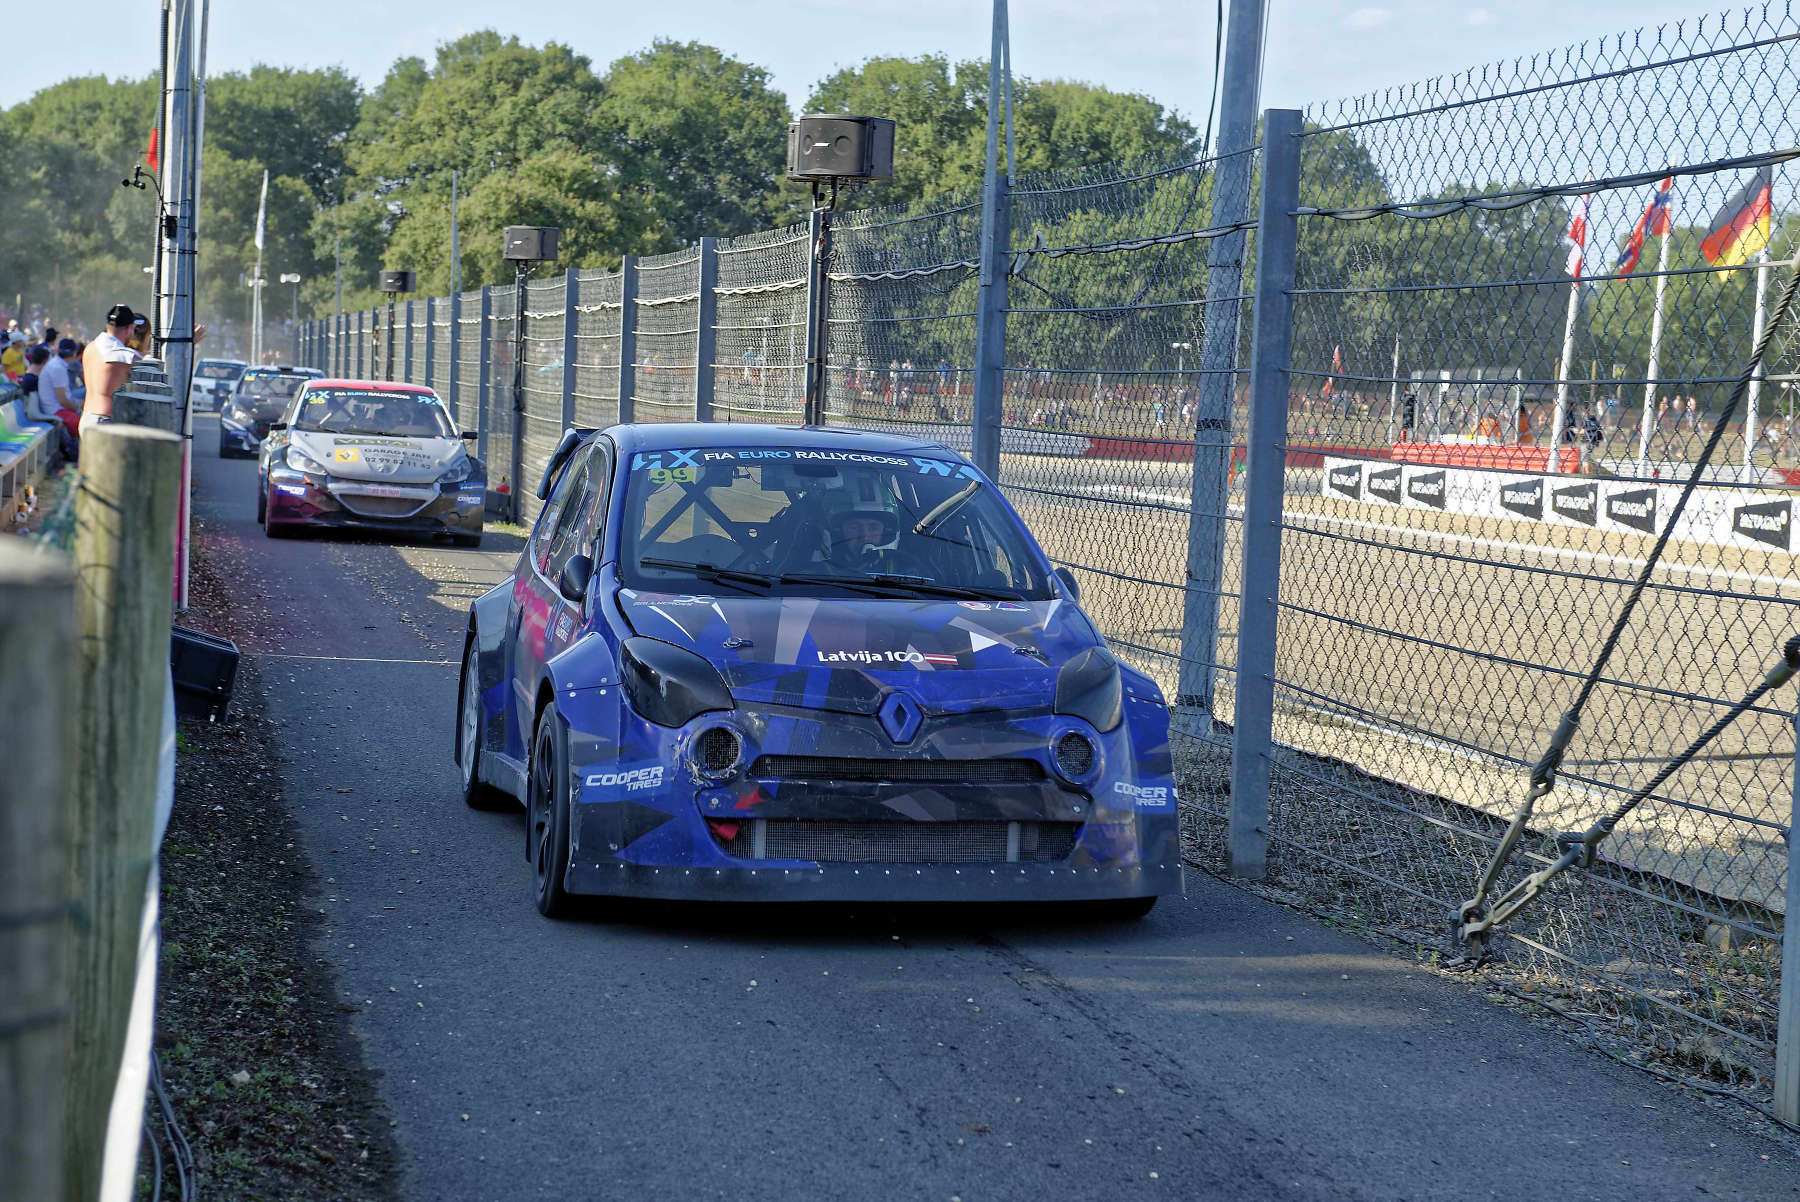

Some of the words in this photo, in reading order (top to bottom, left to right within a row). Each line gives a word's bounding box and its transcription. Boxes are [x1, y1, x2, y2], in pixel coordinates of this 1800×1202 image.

[704, 452, 735, 461] FIA
[739, 451, 791, 459] EURO
[795, 451, 908, 466] RALLYCROSS
[651, 468, 694, 485] 99
[817, 651, 883, 664] Latvija
[585, 766, 664, 787] COOPER
[626, 778, 663, 791] TIRES
[1114, 781, 1168, 798] COOPER
